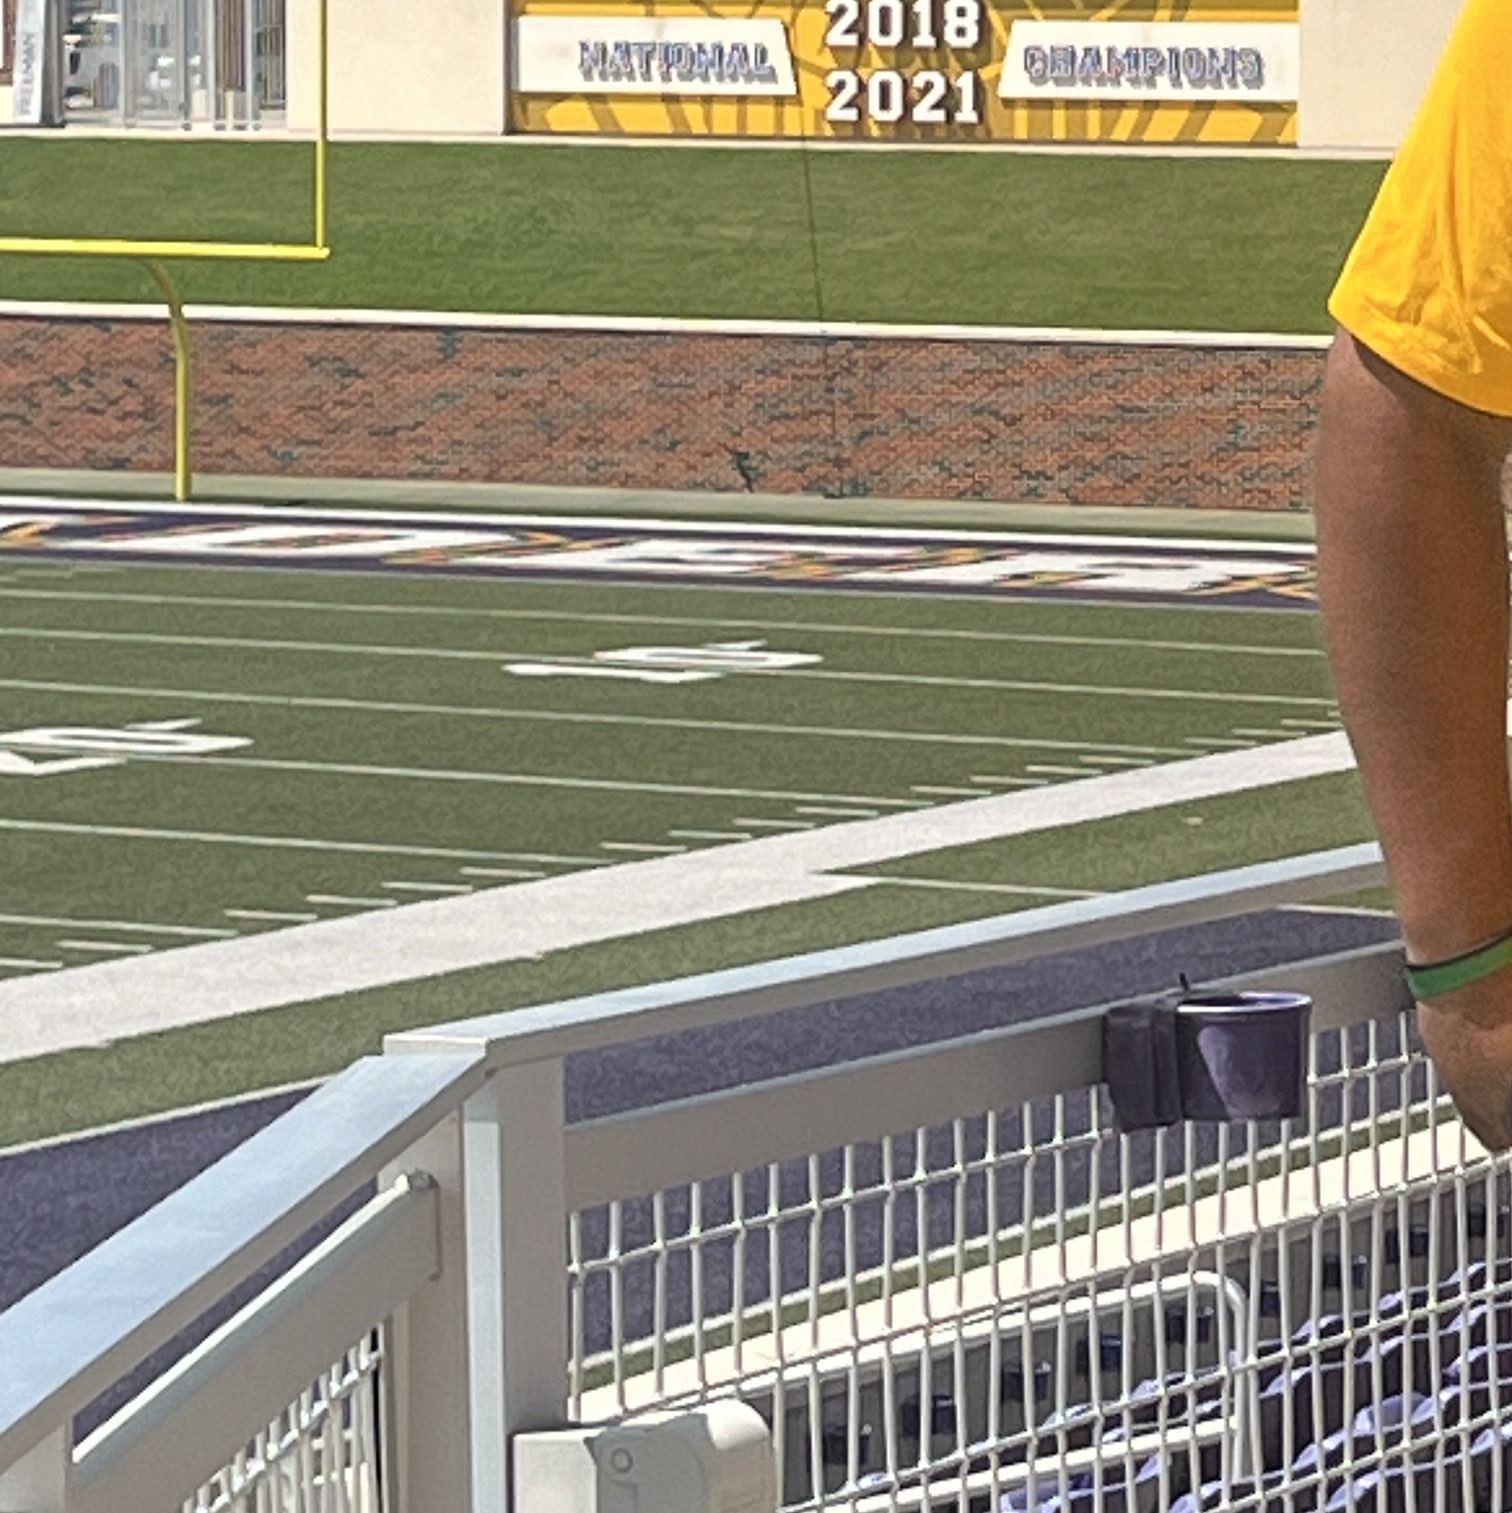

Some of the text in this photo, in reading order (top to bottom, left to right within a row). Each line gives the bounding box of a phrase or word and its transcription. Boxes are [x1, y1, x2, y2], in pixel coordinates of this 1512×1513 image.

[579, 41, 778, 85] NATIONAL
[1024, 45, 1265, 89] CHAMPIONS
[825, 70, 979, 124] 2021
